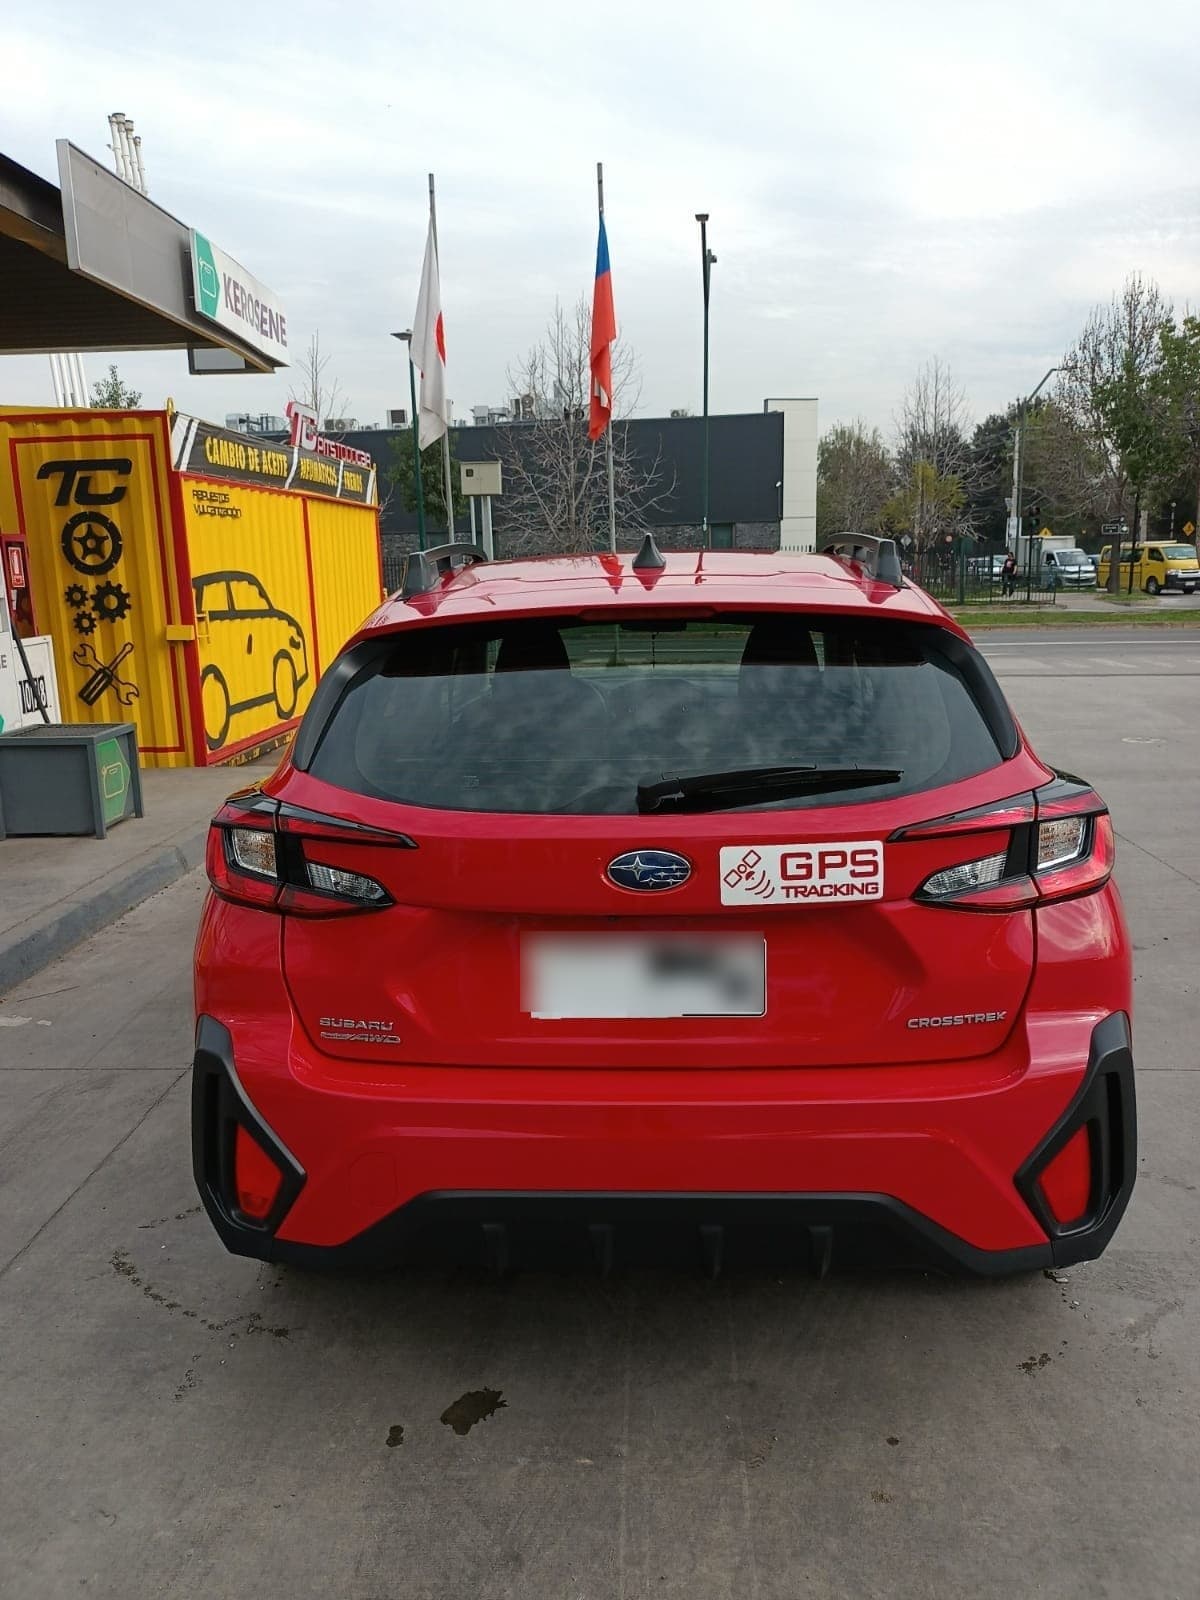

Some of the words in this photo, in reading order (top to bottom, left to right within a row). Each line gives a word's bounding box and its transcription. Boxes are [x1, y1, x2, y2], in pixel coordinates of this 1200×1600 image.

[222, 271, 287, 347] KEROSENE
[284, 400, 318, 451] TC
[205, 435, 246, 470] CAMBIO
[247, 446, 260, 472] DE
[262, 449, 288, 478] ACEITE
[37, 458, 132, 506] TC
[780, 849, 880, 881] GPS
[780, 882, 880, 898] TRACKING
[319, 1017, 394, 1031] SUBARU
[907, 1010, 1008, 1029] CROSSTREK
